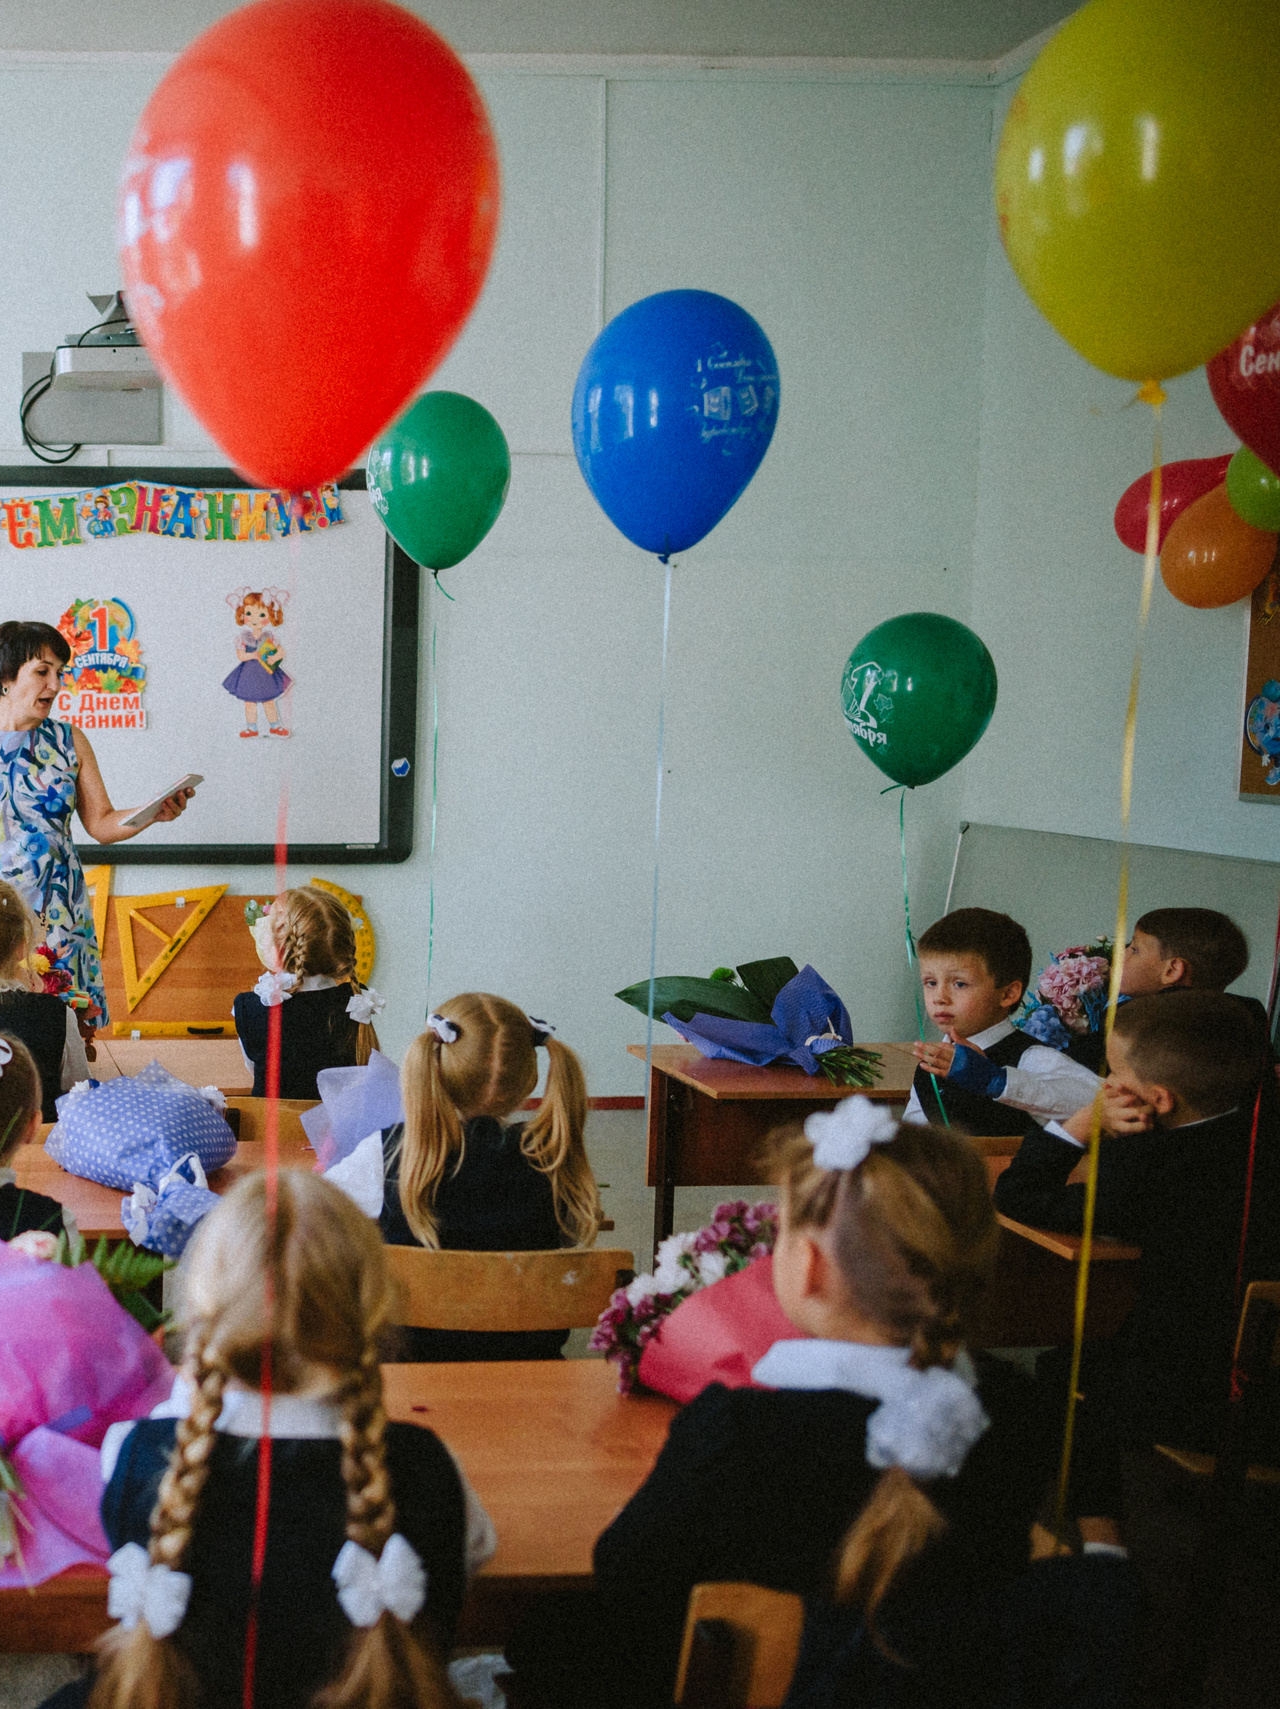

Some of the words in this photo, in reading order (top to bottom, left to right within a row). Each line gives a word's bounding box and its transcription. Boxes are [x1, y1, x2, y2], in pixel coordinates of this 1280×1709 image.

[1240, 345, 1280, 377] Сен
[89, 606, 108, 651] 1
[74, 652, 129, 669] СЕНТЯБРЯ
[58, 694, 71, 711] С
[79, 693, 140, 713] Днем
